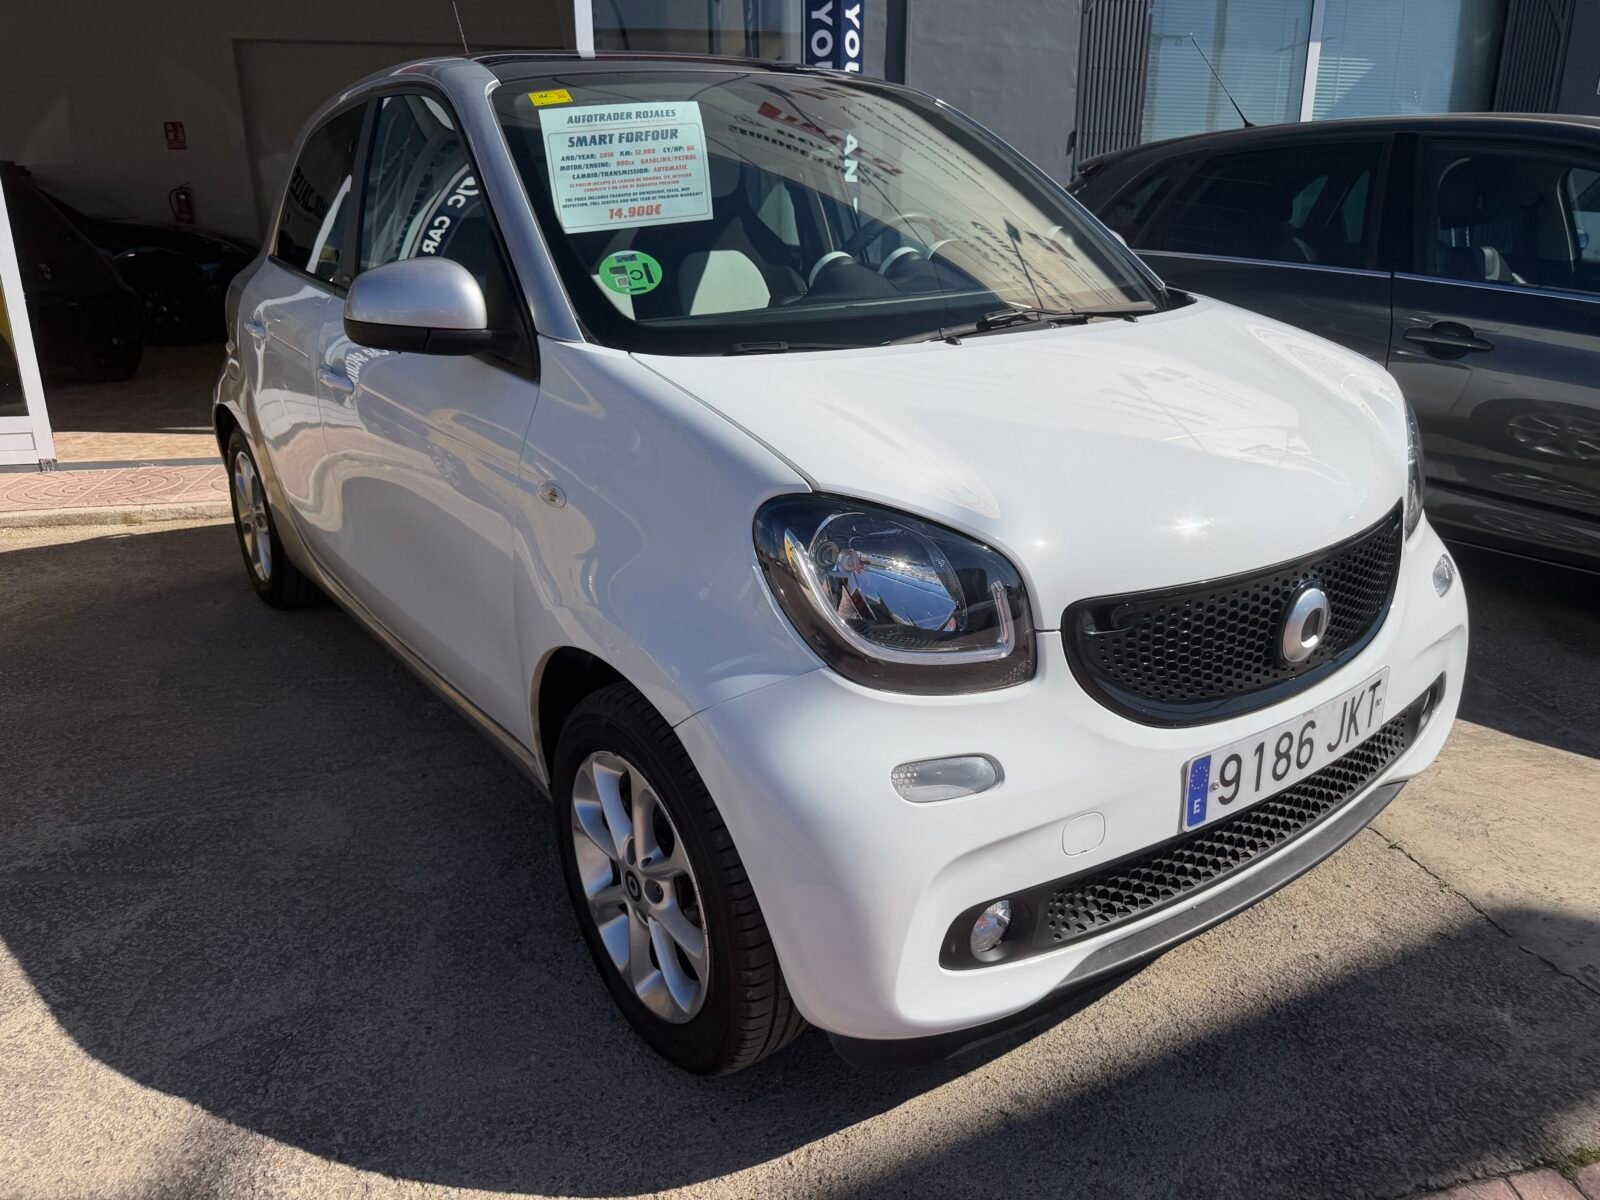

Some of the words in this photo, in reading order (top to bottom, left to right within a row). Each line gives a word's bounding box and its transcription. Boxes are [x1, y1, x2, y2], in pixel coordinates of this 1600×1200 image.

[811, 1, 833, 69] YO
[567, 111, 633, 124] AUTOTRADER
[635, 109, 676, 120] ROJALES
[568, 133, 615, 148] SMART
[618, 128, 679, 143] FORFOUR
[663, 145, 685, 153] CV/HP:
[560, 161, 612, 171] MOTOR/ENGINE:
[640, 154, 697, 165] GASOLINA/PETROL
[572, 168, 650, 180] CAMBIO/TRANSMISSION:
[608, 203, 663, 220] 14.900€
[1217, 719, 1317, 806] 9186
[1326, 679, 1382, 753] JKT
[1193, 798, 1201, 815] E
